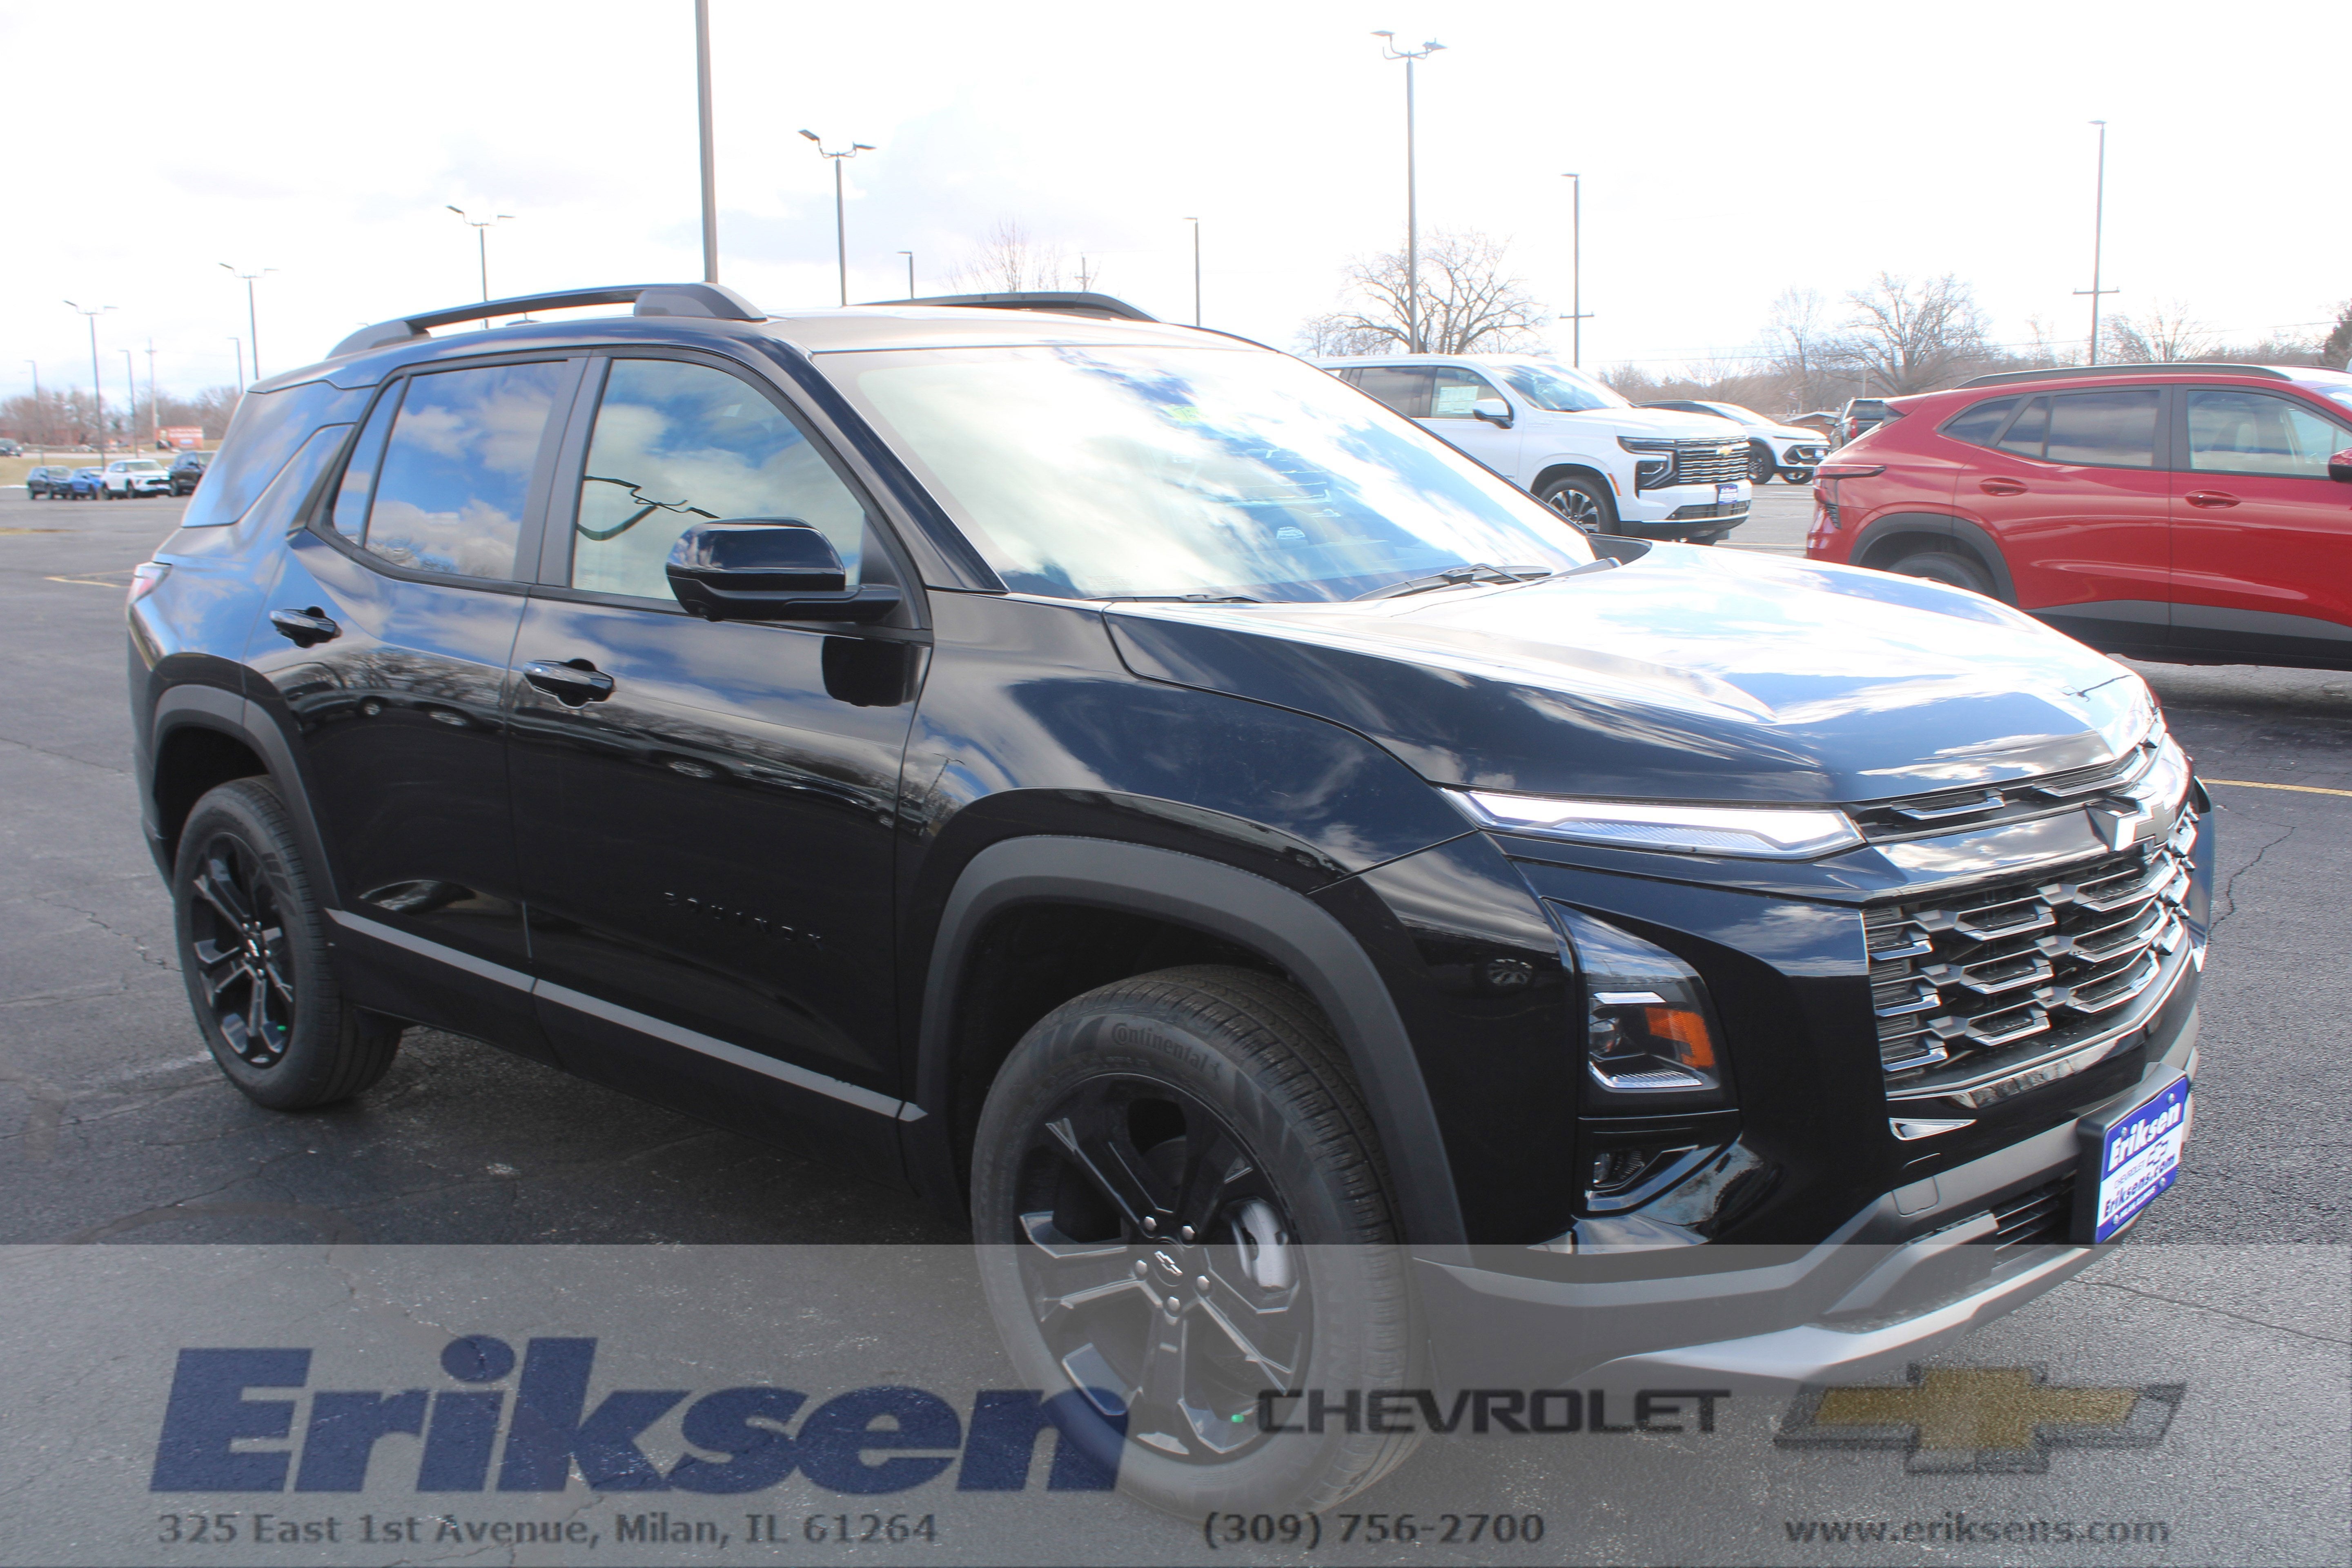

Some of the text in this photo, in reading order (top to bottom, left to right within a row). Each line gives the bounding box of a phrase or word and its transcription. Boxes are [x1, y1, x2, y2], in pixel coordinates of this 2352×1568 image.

[1111, 1022, 1209, 1071] Continental
[2107, 1102, 2181, 1172] Eriksen
[2104, 1154, 2175, 1219] Eriksens.com
[2114, 1160, 2145, 1189] CHEVROLET
